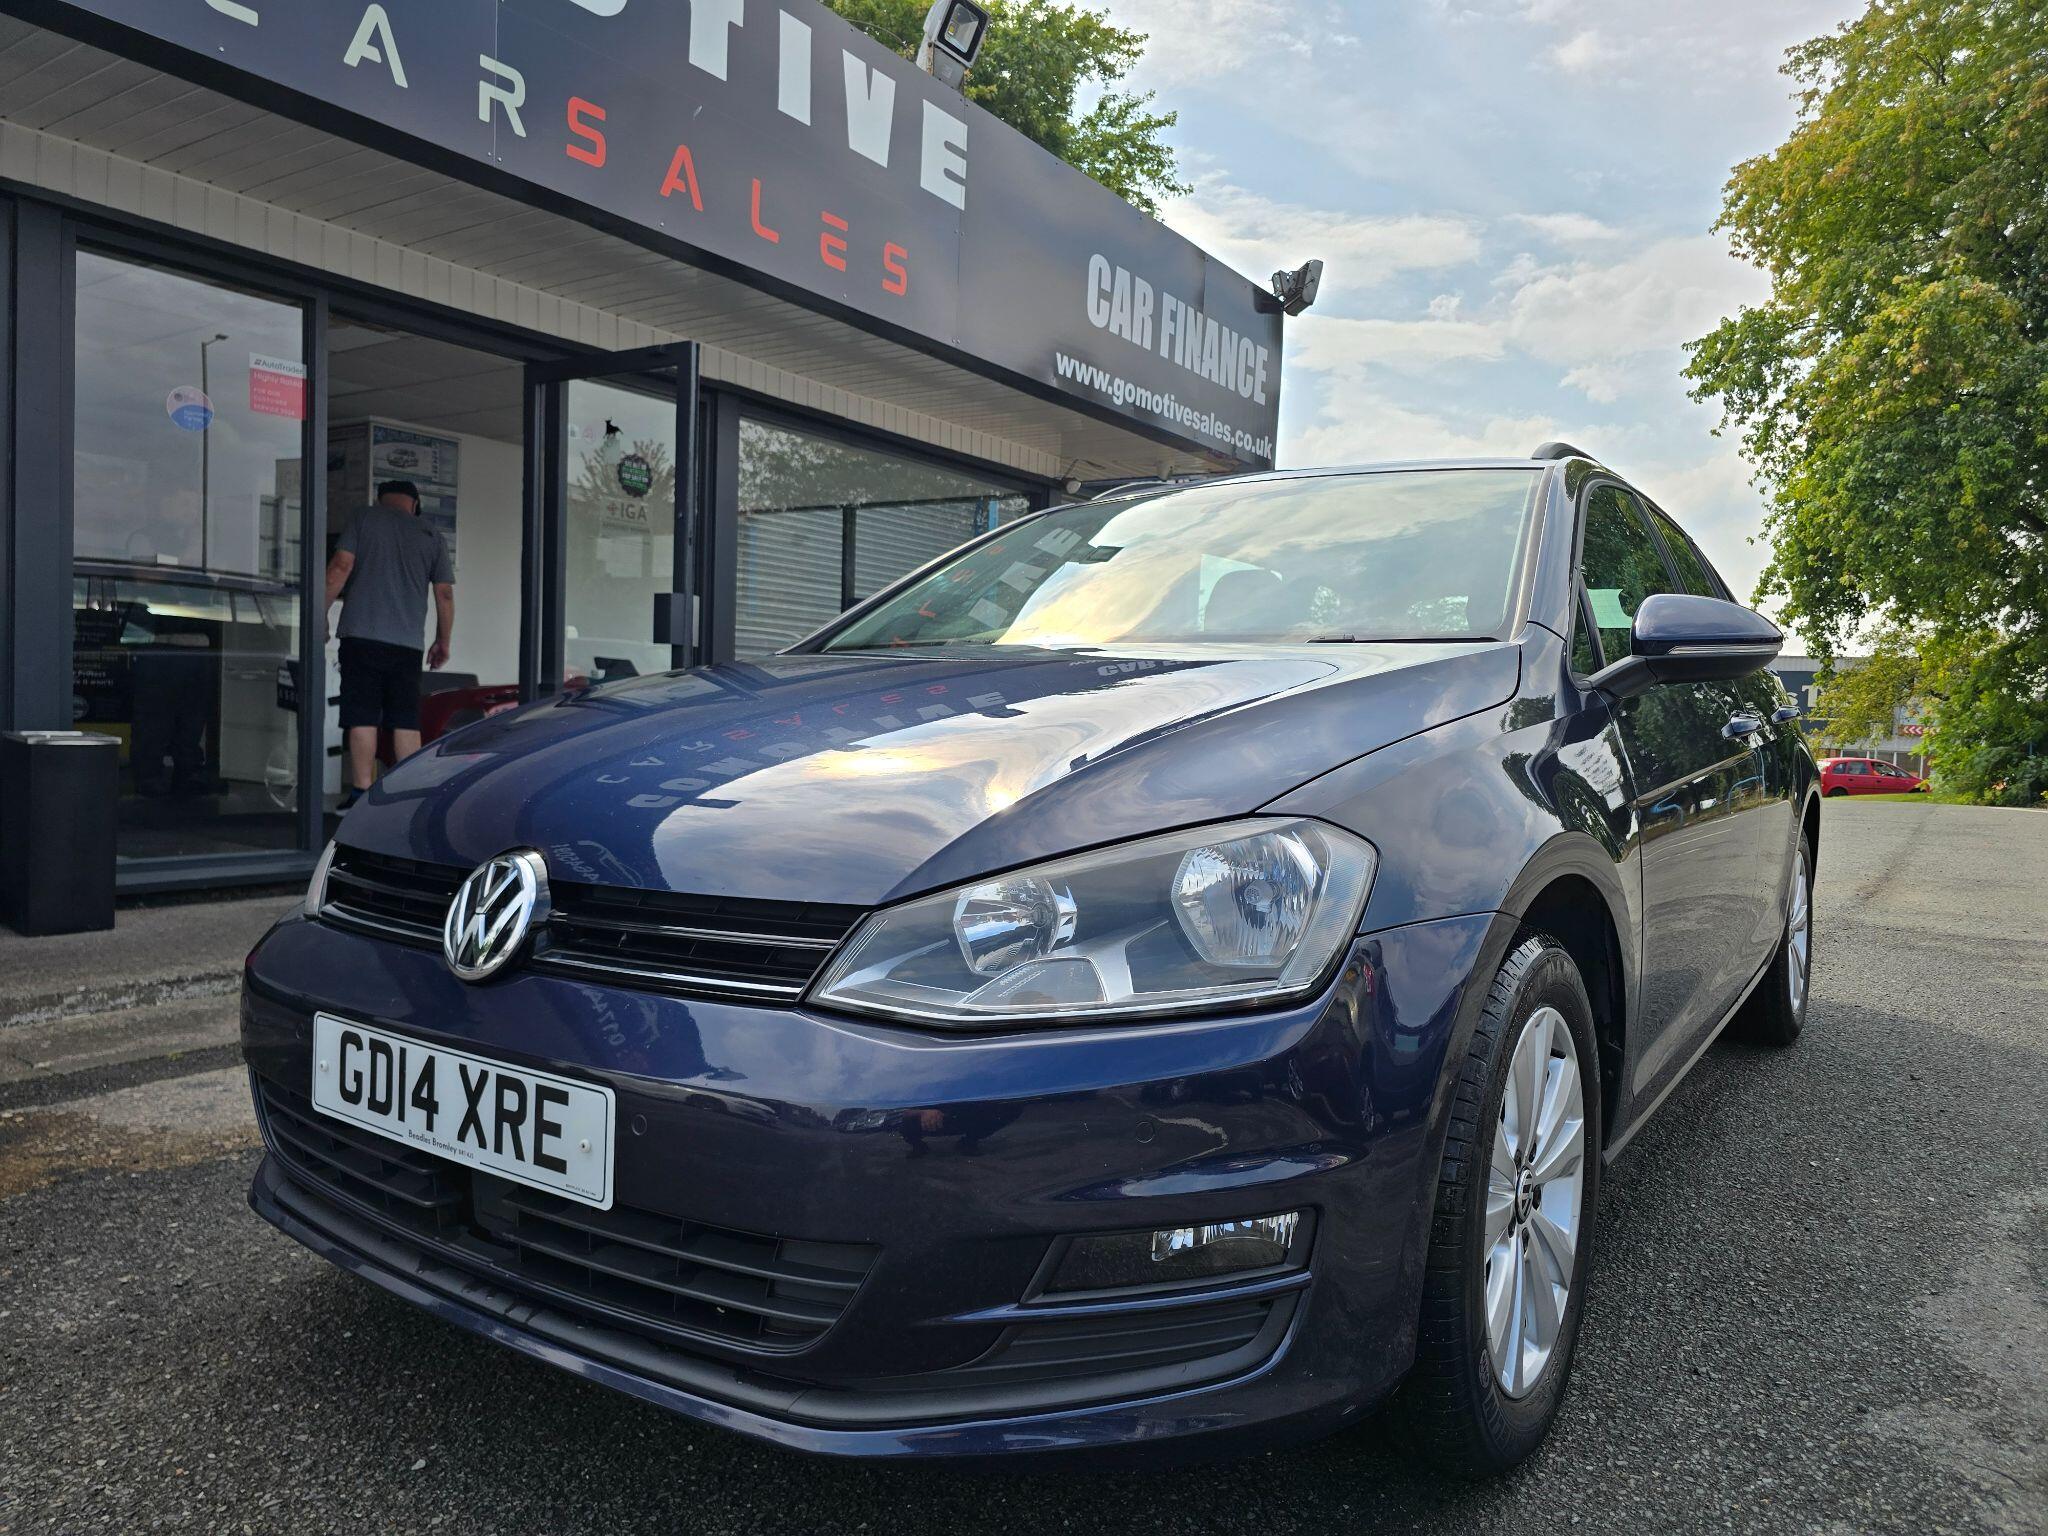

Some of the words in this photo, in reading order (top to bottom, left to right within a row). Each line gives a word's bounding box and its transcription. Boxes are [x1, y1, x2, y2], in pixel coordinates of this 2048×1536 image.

[211, 0, 526, 138] AR
[566, 96, 908, 296] SALES
[570, 0, 968, 211] TIVE
[1087, 253, 1154, 351] CAR
[1160, 292, 1268, 406] FINANCE
[1056, 352, 1273, 460] www.gomotivesales.co.uk
[339, 1030, 439, 1132] GD14
[457, 1063, 569, 1175] XRE
[408, 1129, 431, 1145] Beadles
[433, 1137, 457, 1157] Bromley
